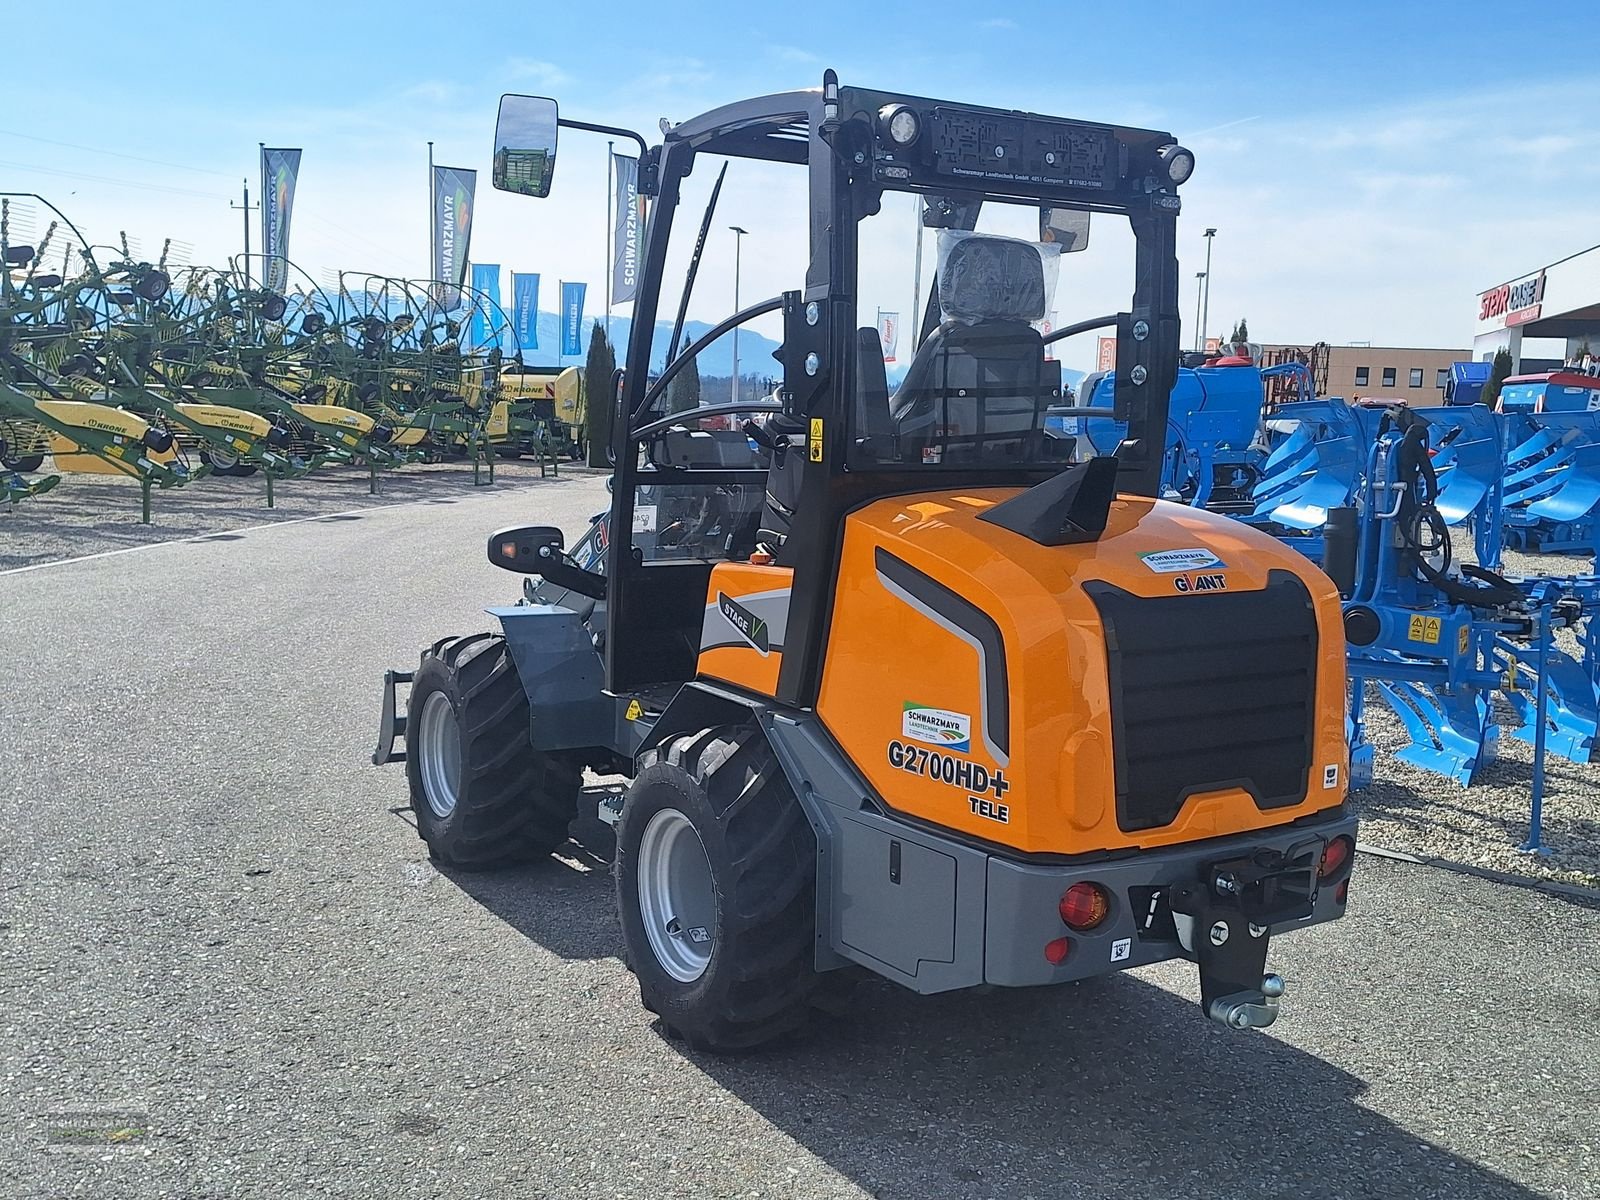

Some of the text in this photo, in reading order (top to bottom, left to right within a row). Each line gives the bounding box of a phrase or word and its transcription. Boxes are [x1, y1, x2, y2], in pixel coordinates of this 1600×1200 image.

[624, 183, 636, 286] SCHWARZMAYR
[1509, 279, 1537, 311] CASE
[569, 302, 578, 340] LEMKEN
[97, 422, 128, 434] KRONE
[228, 422, 255, 431] KRONE
[1146, 553, 1206, 562] SCHWARZMAYR
[724, 603, 749, 633] STAGE
[908, 711, 960, 731] SCHWARZMAYR
[908, 721, 939, 733] LANDTECHNIK
[888, 740, 1010, 800] G2700HD+
[968, 796, 1009, 824] TELE
